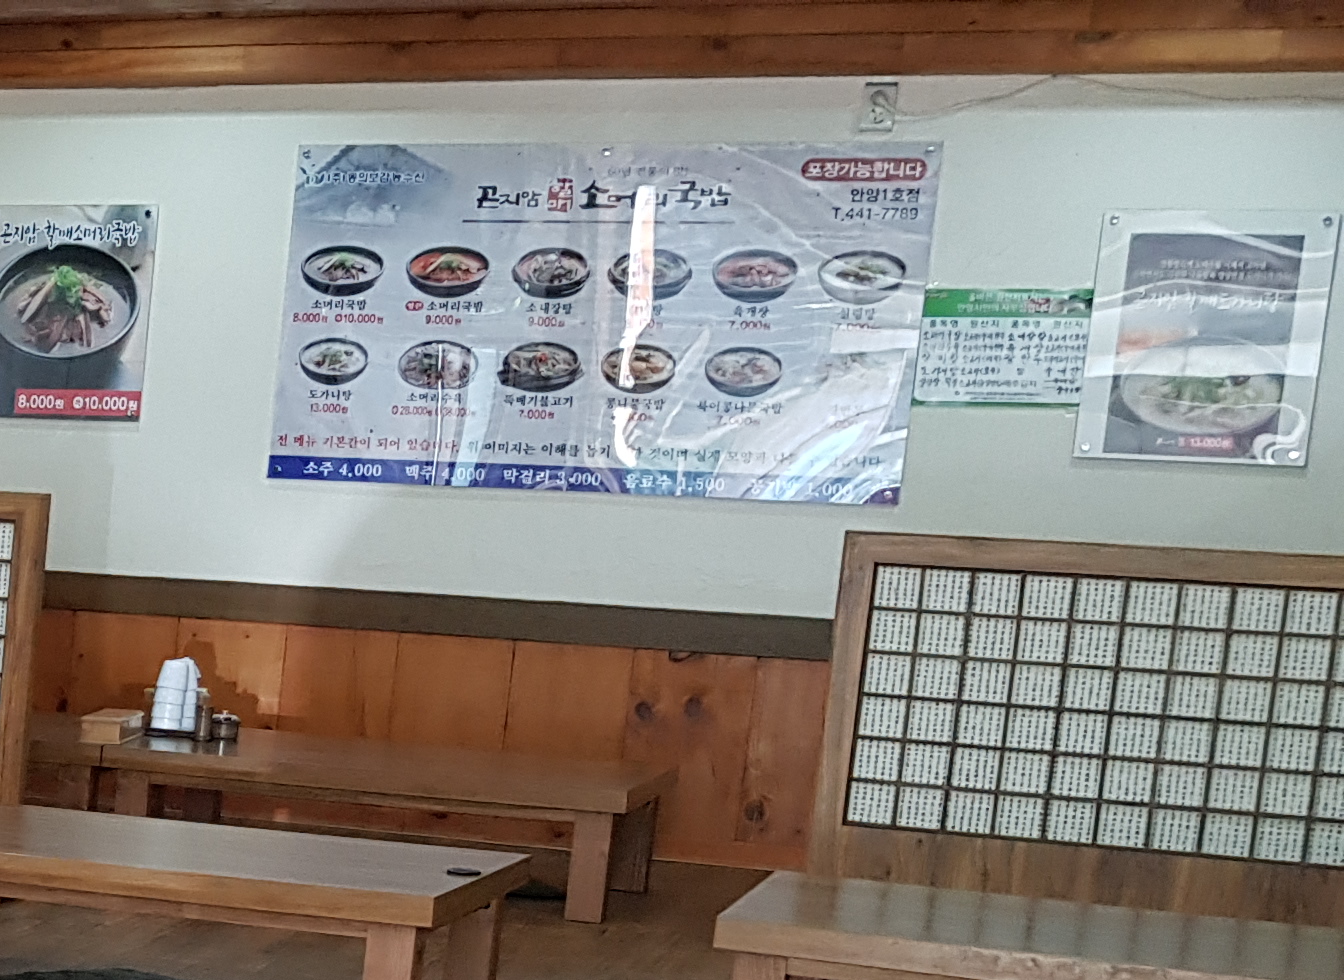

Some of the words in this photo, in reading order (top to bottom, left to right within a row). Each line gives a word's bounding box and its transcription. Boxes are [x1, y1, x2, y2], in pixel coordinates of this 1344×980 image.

[805, 161, 924, 179] 포장가능합니다
[850, 188, 921, 204] 안양1호점
[831, 207, 919, 221] T.441-7789
[310, 299, 368, 311] 소머리국밥
[426, 300, 484, 312] 소머리국밥
[308, 389, 353, 402] 도가니탕
[302, 461, 335, 477] 소주
[338, 464, 383, 478] 4,000
[404, 464, 435, 480] 맥주
[502, 468, 550, 485] 막걸리
